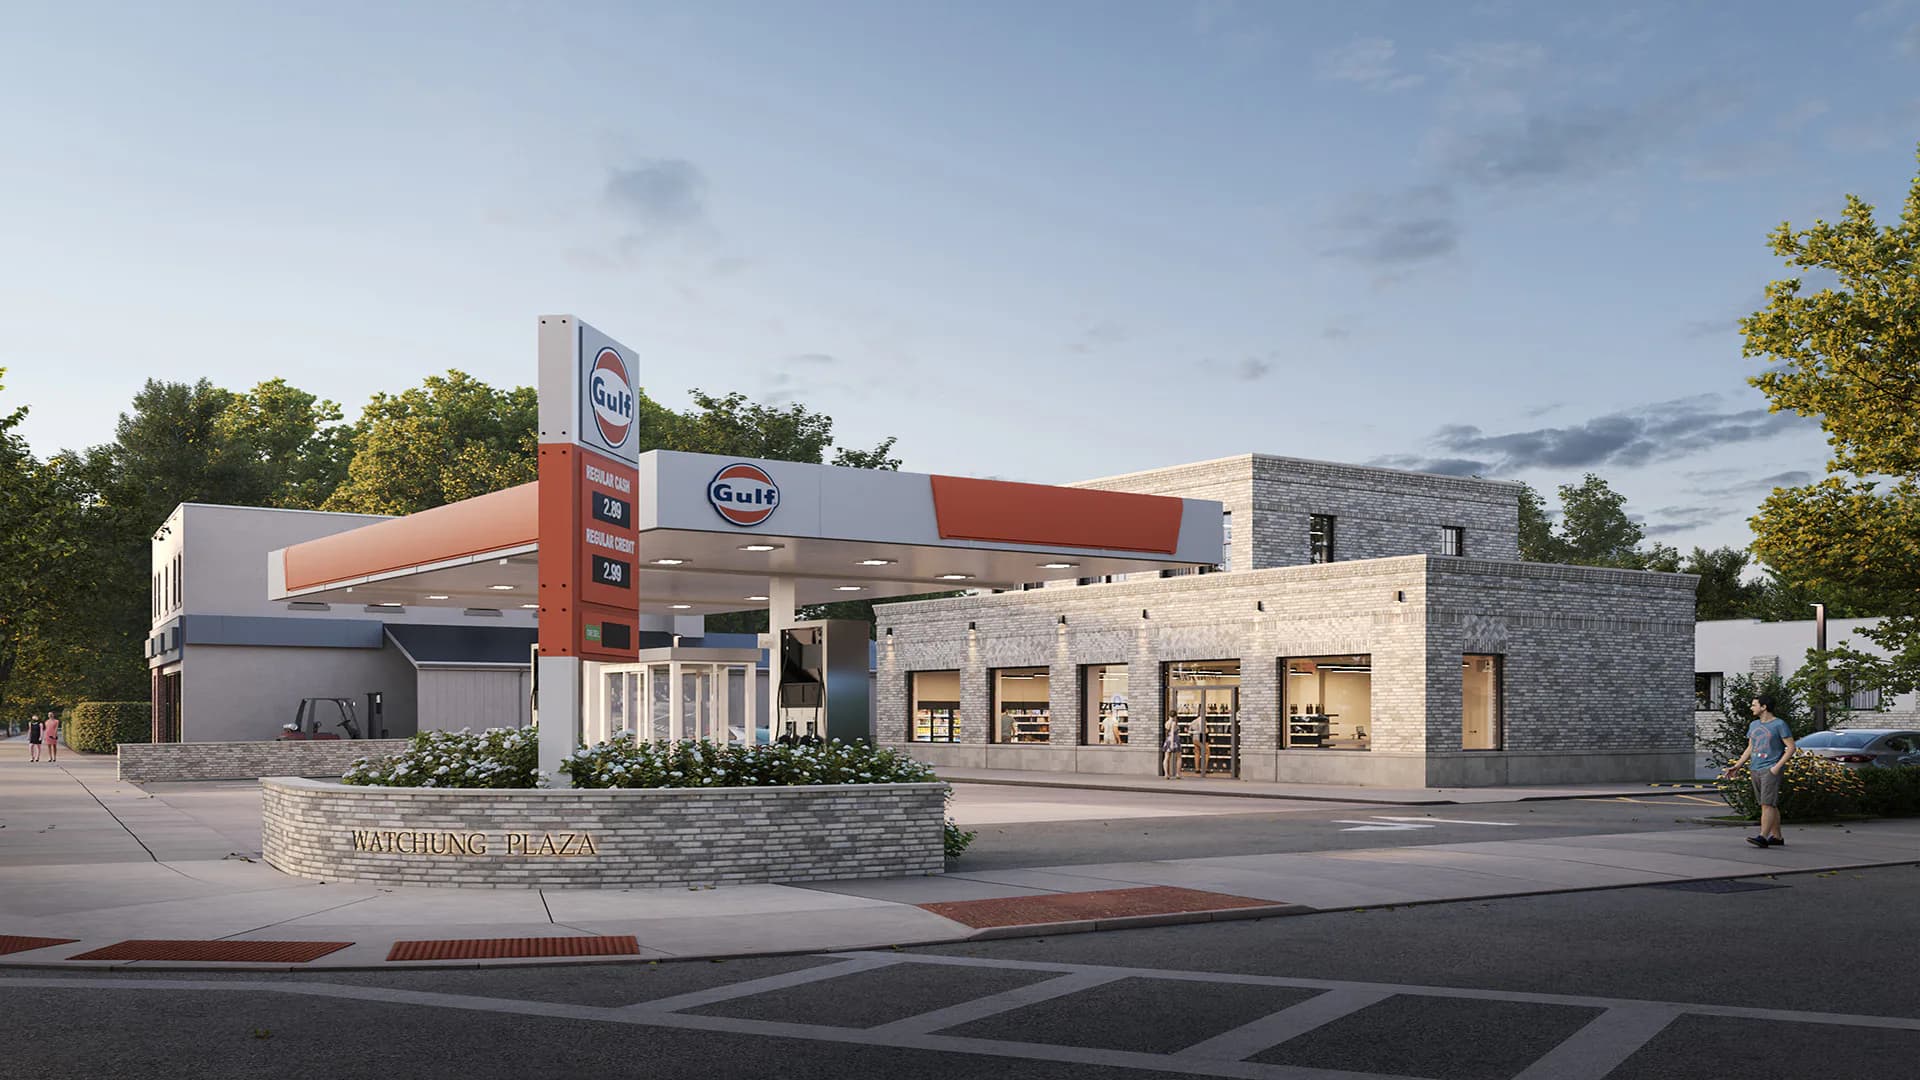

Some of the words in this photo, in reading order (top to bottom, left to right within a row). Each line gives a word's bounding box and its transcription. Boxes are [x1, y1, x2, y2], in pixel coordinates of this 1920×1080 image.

[592, 375, 631, 418] Gulf
[586, 465, 614, 487] REGULAR
[614, 477, 630, 493] CASH
[713, 483, 776, 505] Gulf
[603, 498, 622, 519] 2.89
[586, 528, 614, 549] REGULAR
[615, 537, 635, 555] CREDIT
[603, 562, 622, 582] 2.99
[352, 830, 487, 855] WATCHUNG
[506, 832, 597, 856] PLAZA
